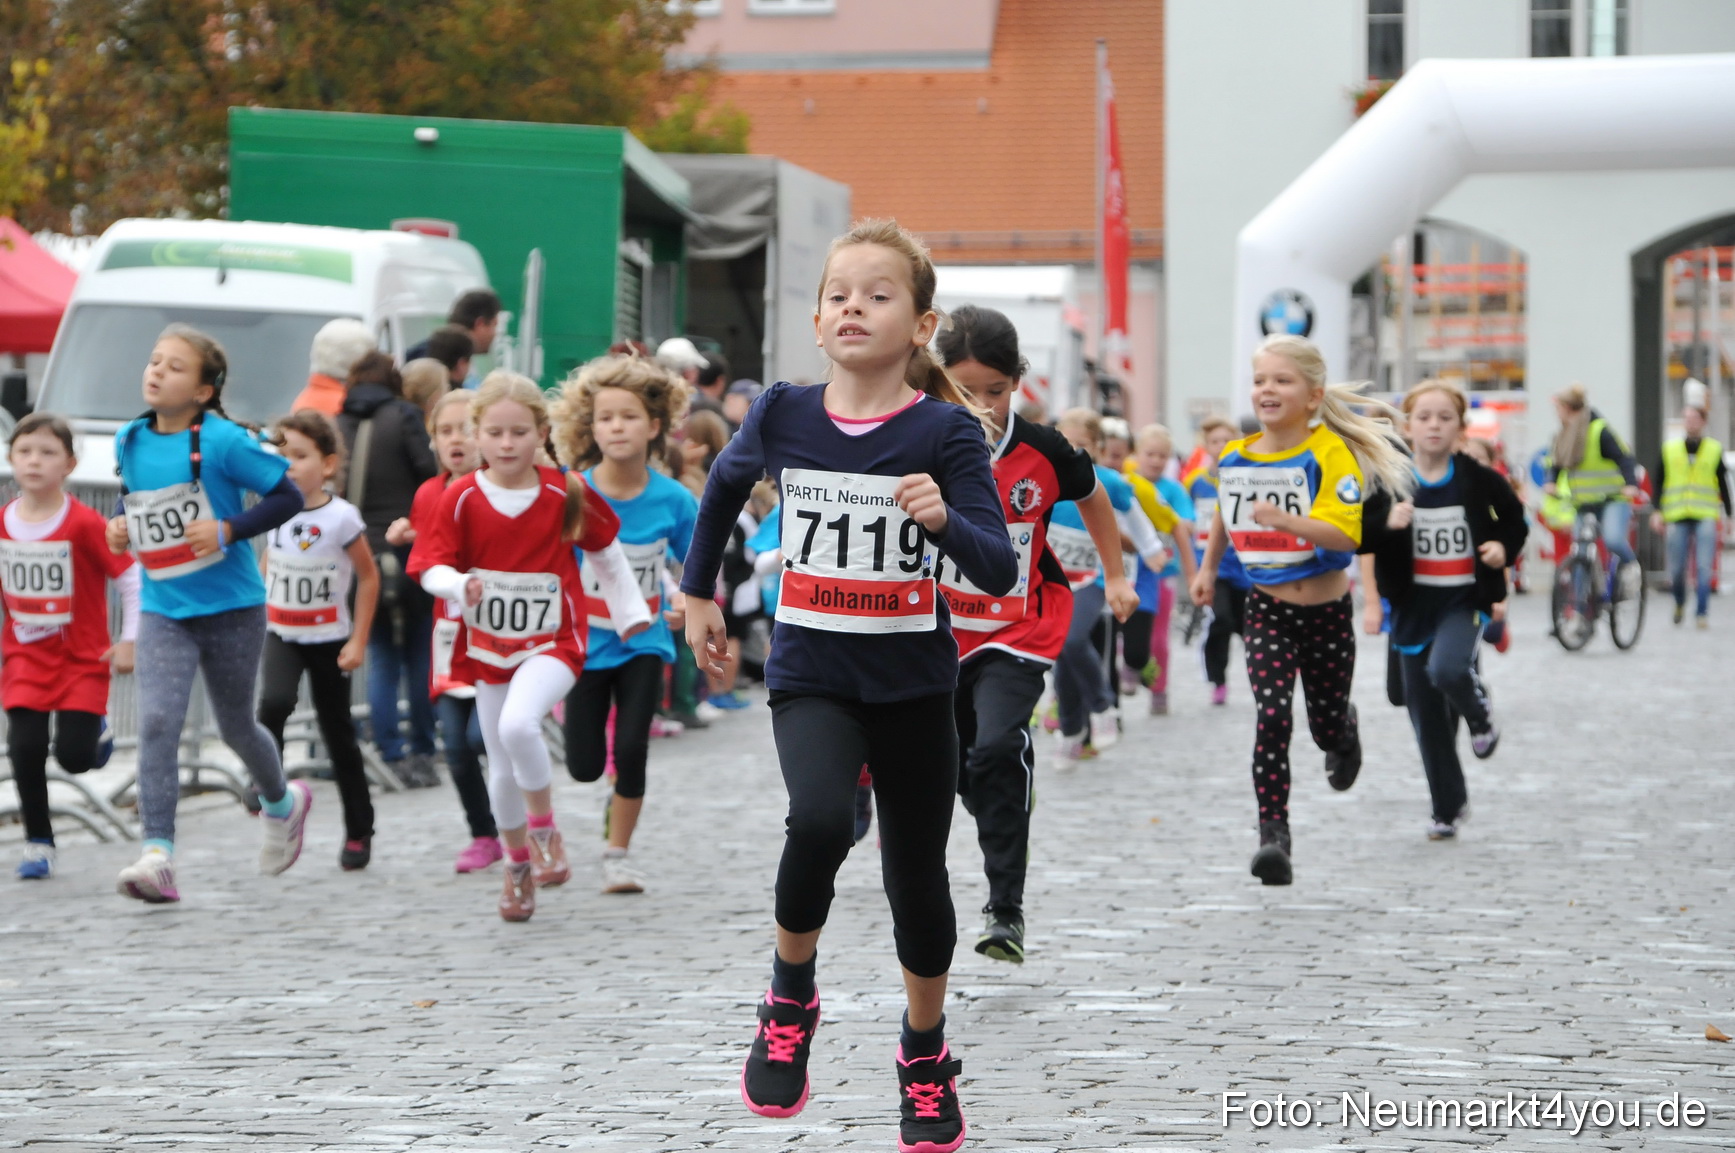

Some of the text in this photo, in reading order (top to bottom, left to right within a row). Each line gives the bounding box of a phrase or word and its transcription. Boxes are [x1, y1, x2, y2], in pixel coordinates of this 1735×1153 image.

[785, 483, 833, 503] PARTL
[132, 500, 199, 546] 7592
[796, 509, 926, 574] 7119
[268, 570, 332, 605] 7104
[809, 583, 899, 612] Johanna
[943, 590, 986, 615] Sarah
